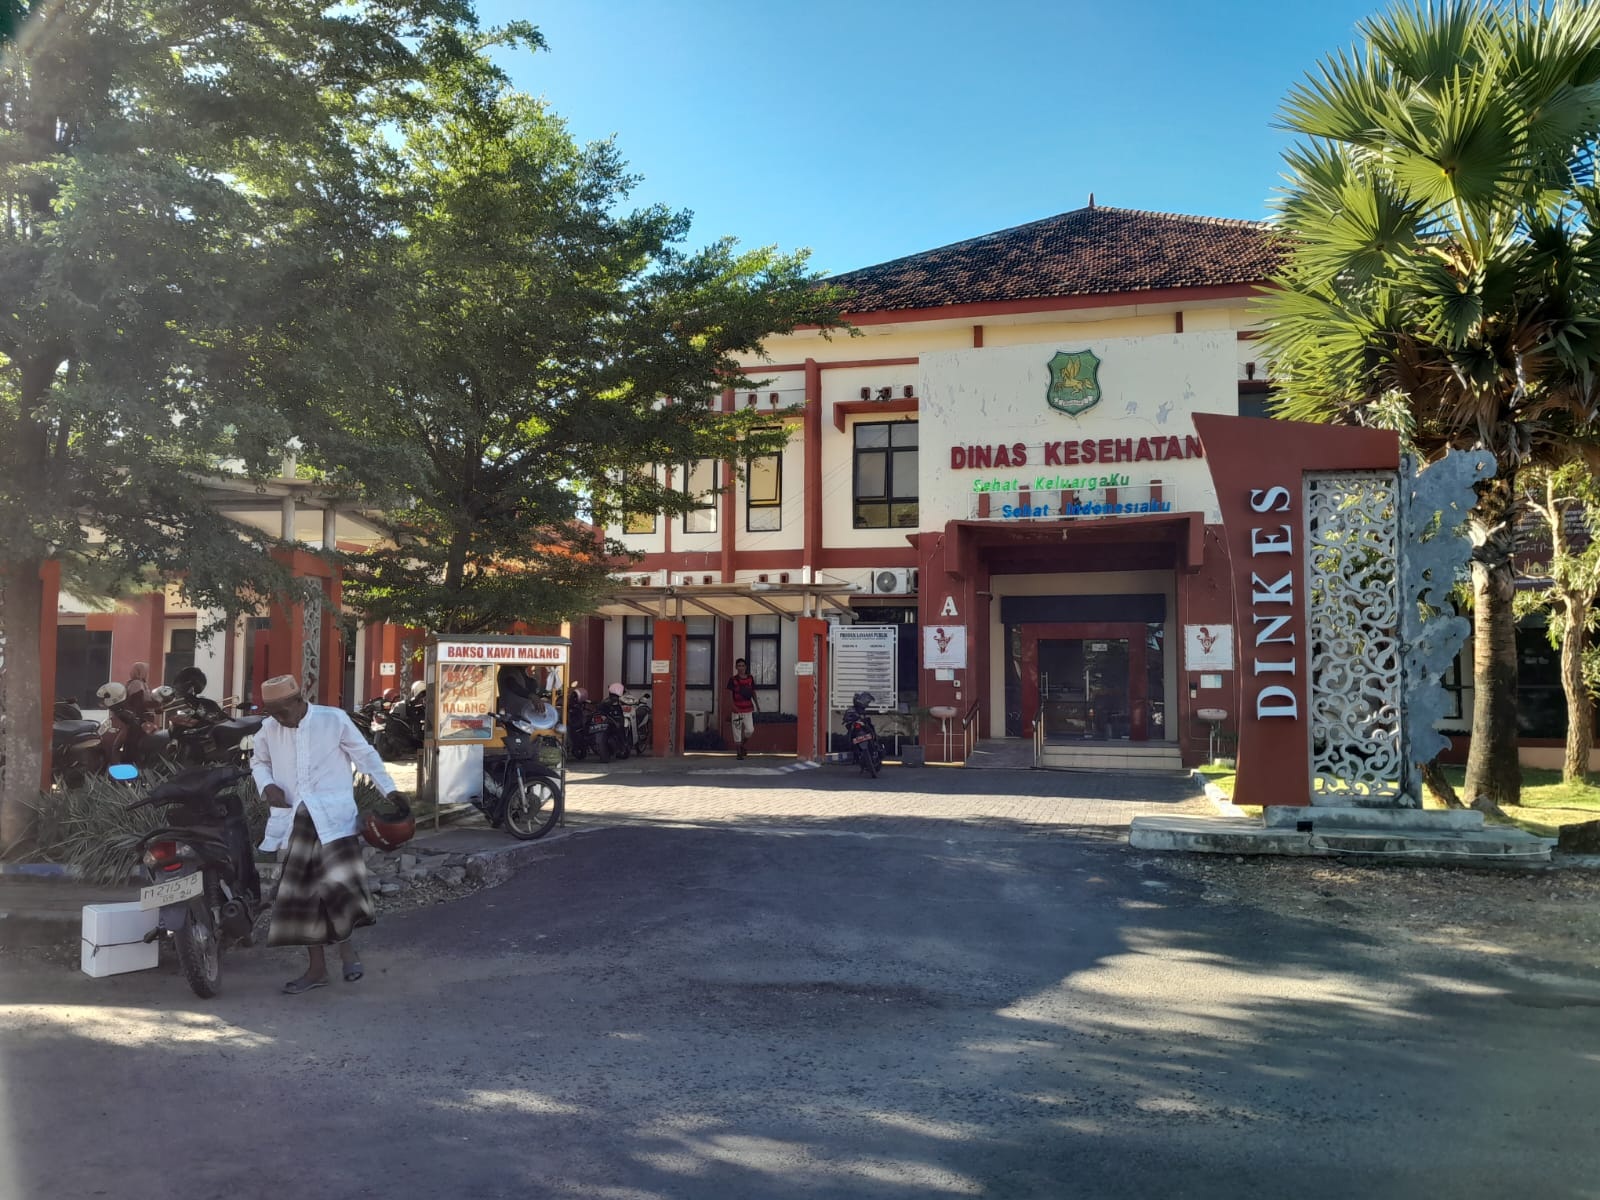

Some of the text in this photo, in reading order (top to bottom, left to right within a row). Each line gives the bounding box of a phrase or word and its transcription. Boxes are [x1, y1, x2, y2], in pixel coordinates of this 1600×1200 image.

[951, 435, 1203, 469] DINAS KESEHATAN
[973, 477, 1019, 492] Sehat
[1002, 498, 1171, 518] Sehat Indonesiaku
[941, 596, 959, 616] A
[1250, 486, 1298, 720] DINKES
[447, 646, 560, 659] BAKSO KAWI MALANG
[443, 703, 487, 714] MALANG
